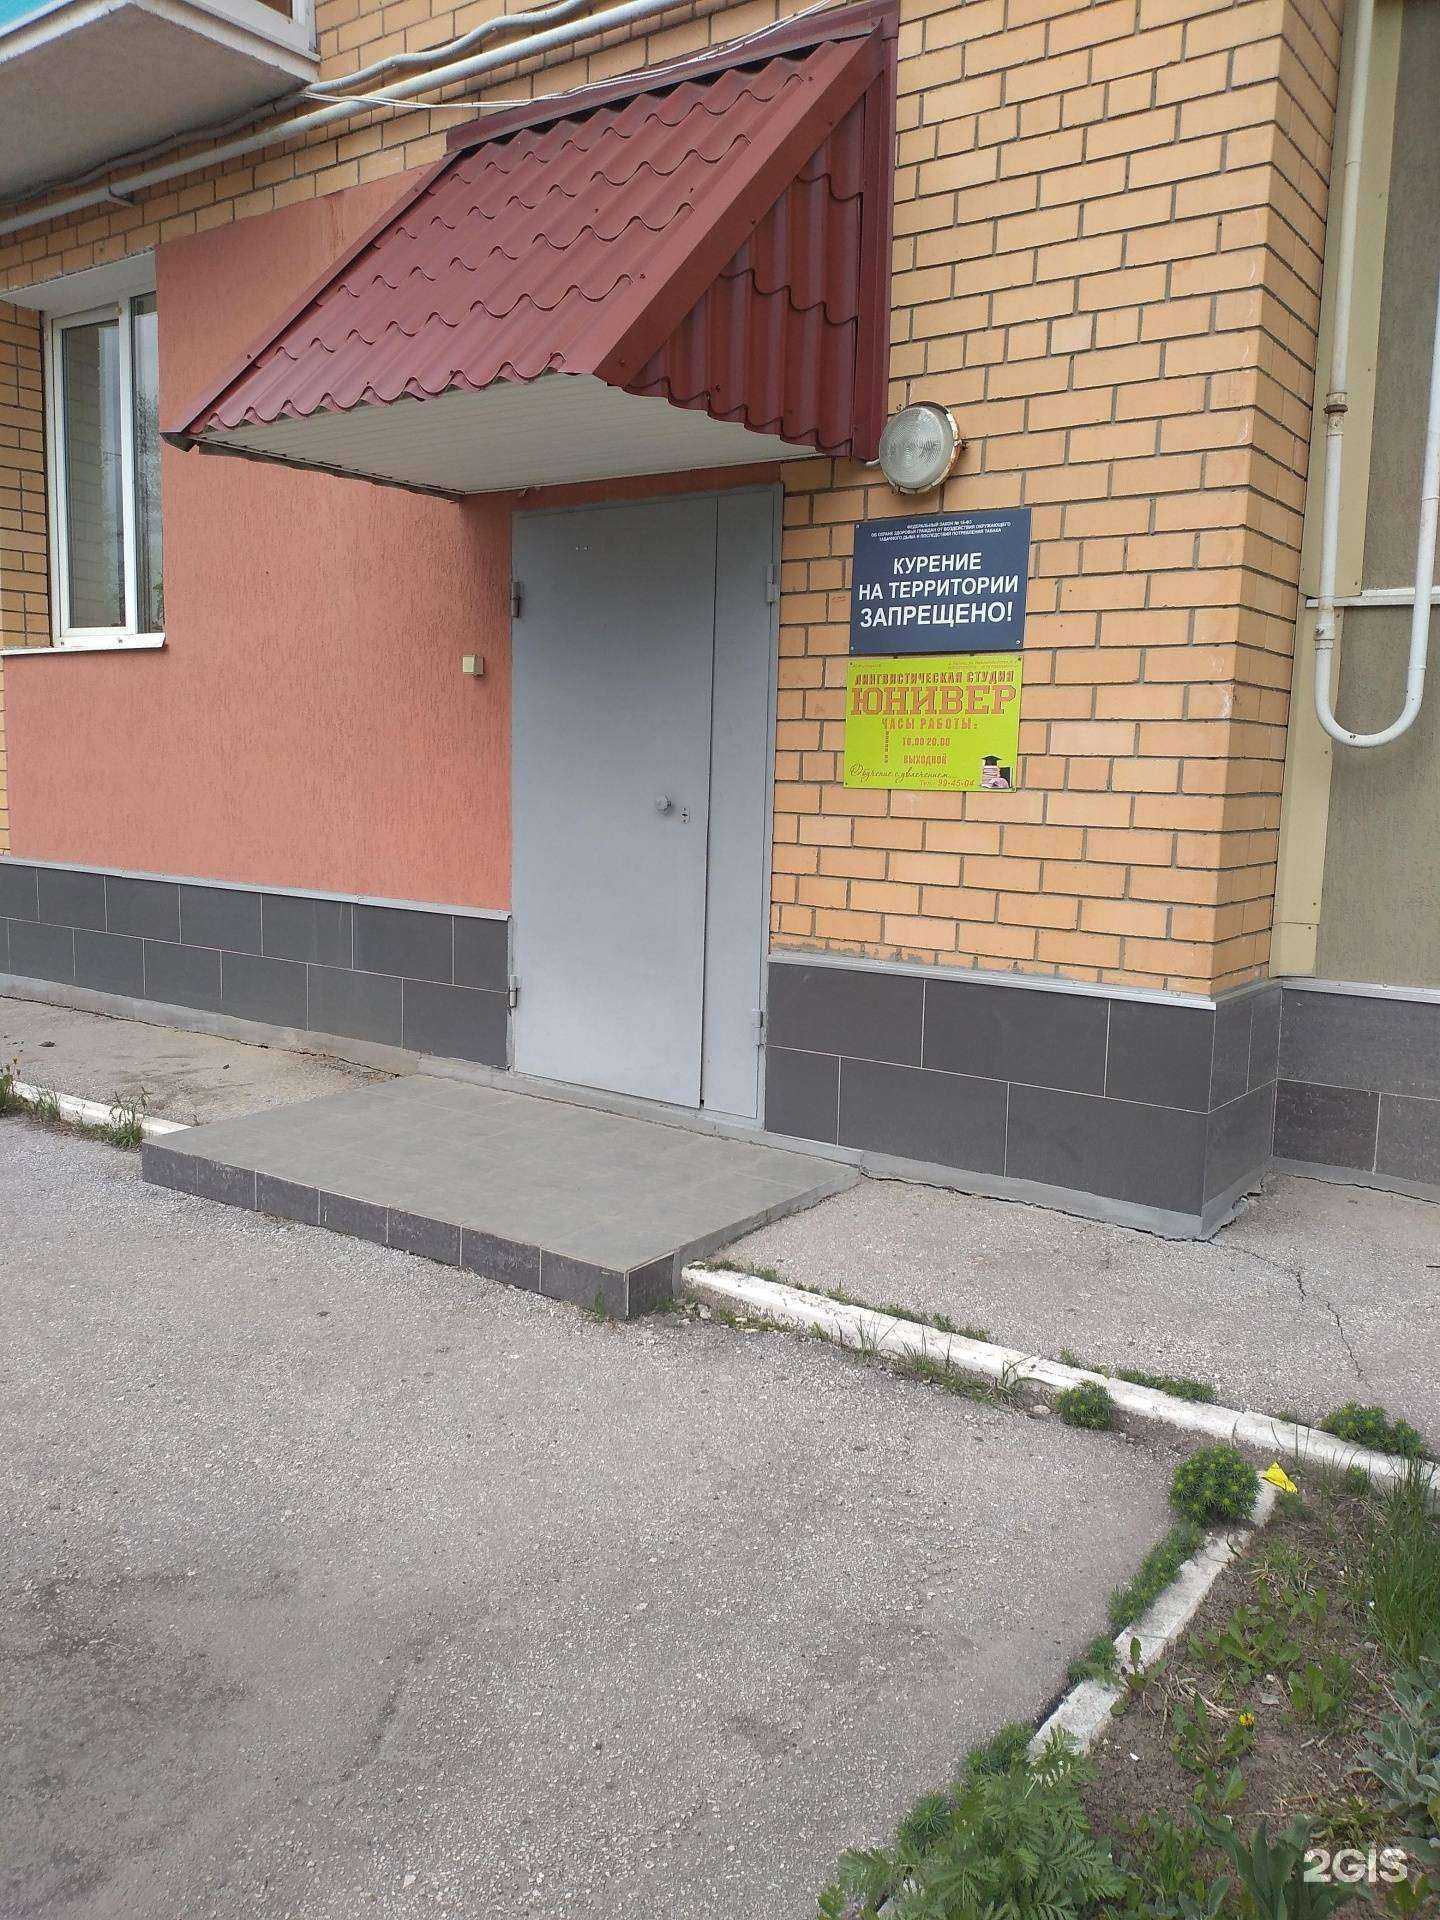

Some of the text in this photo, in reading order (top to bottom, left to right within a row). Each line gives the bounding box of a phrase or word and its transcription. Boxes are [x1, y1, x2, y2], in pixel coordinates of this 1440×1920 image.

[893, 552, 982, 575] КУРЕНИЕ
[858, 575, 1019, 601] НА ТЕРРИТОРИИ
[860, 601, 1014, 628] ЗАПРЕЩЕНО!
[855, 670, 1015, 686] ЛИНГВИСТИЧЕСКАЯ СТУДИЯ
[851, 684, 1017, 716] ЮНИВЕР
[882, 717, 979, 731] ЧАСЫ РАБОТЫ:
[903, 753, 947, 766] ВЫХОДНОЙ
